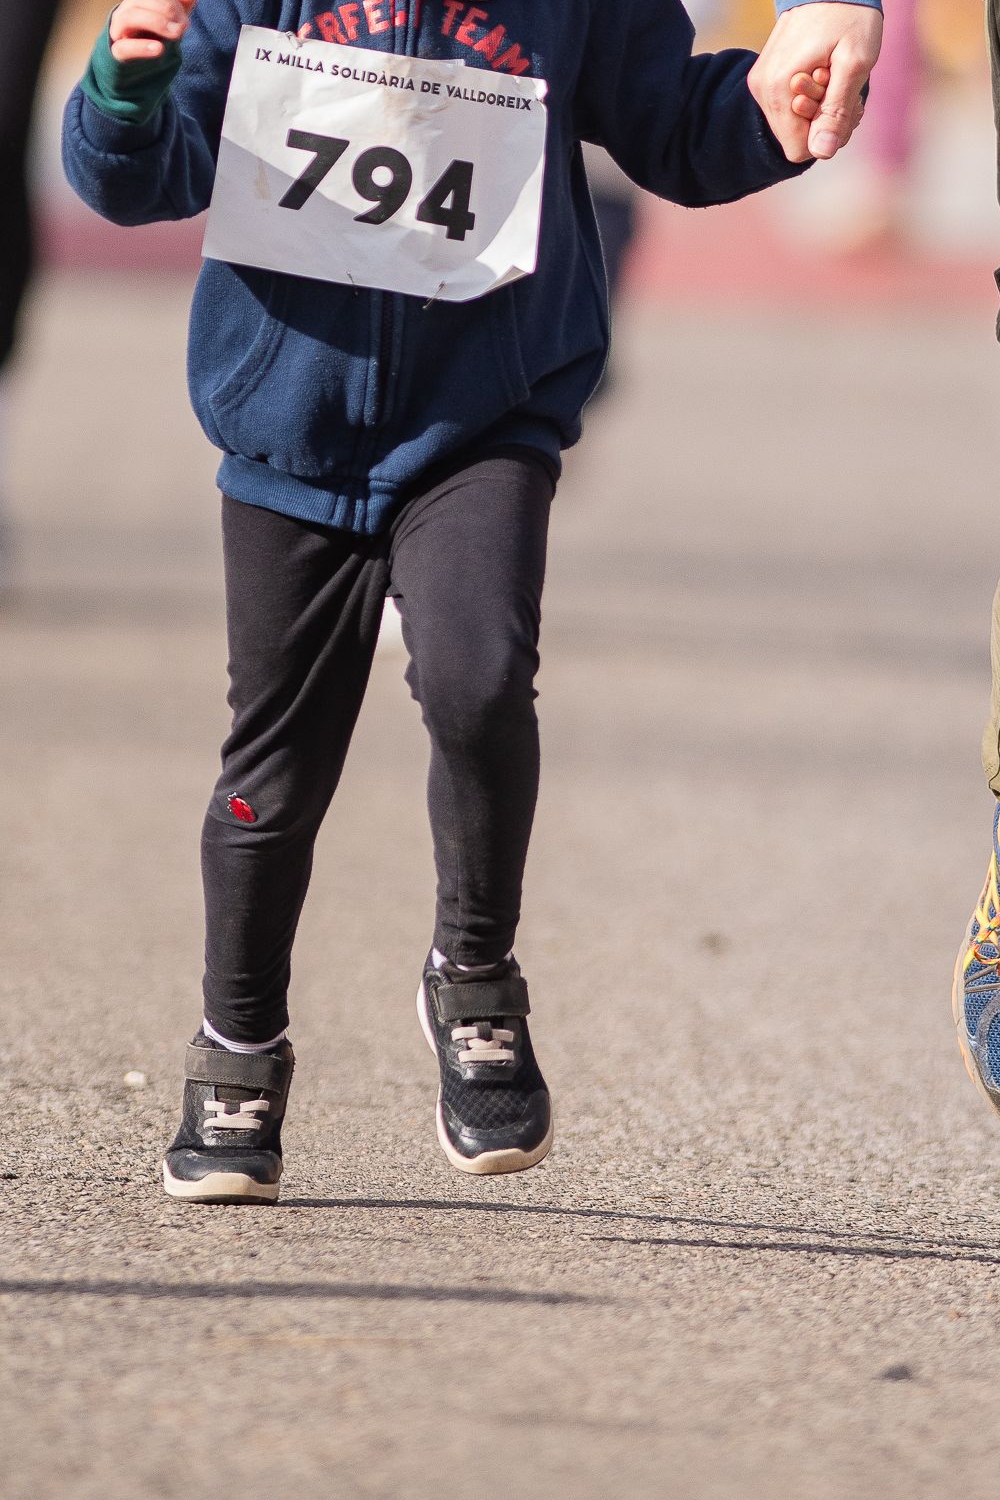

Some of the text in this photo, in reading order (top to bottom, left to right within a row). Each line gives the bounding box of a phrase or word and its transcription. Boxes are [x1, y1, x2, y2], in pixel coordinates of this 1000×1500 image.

[255, 47, 533, 112] IX MILLA SOLIDÀRIA DE VALLDOREIX
[278, 128, 476, 242] 794
